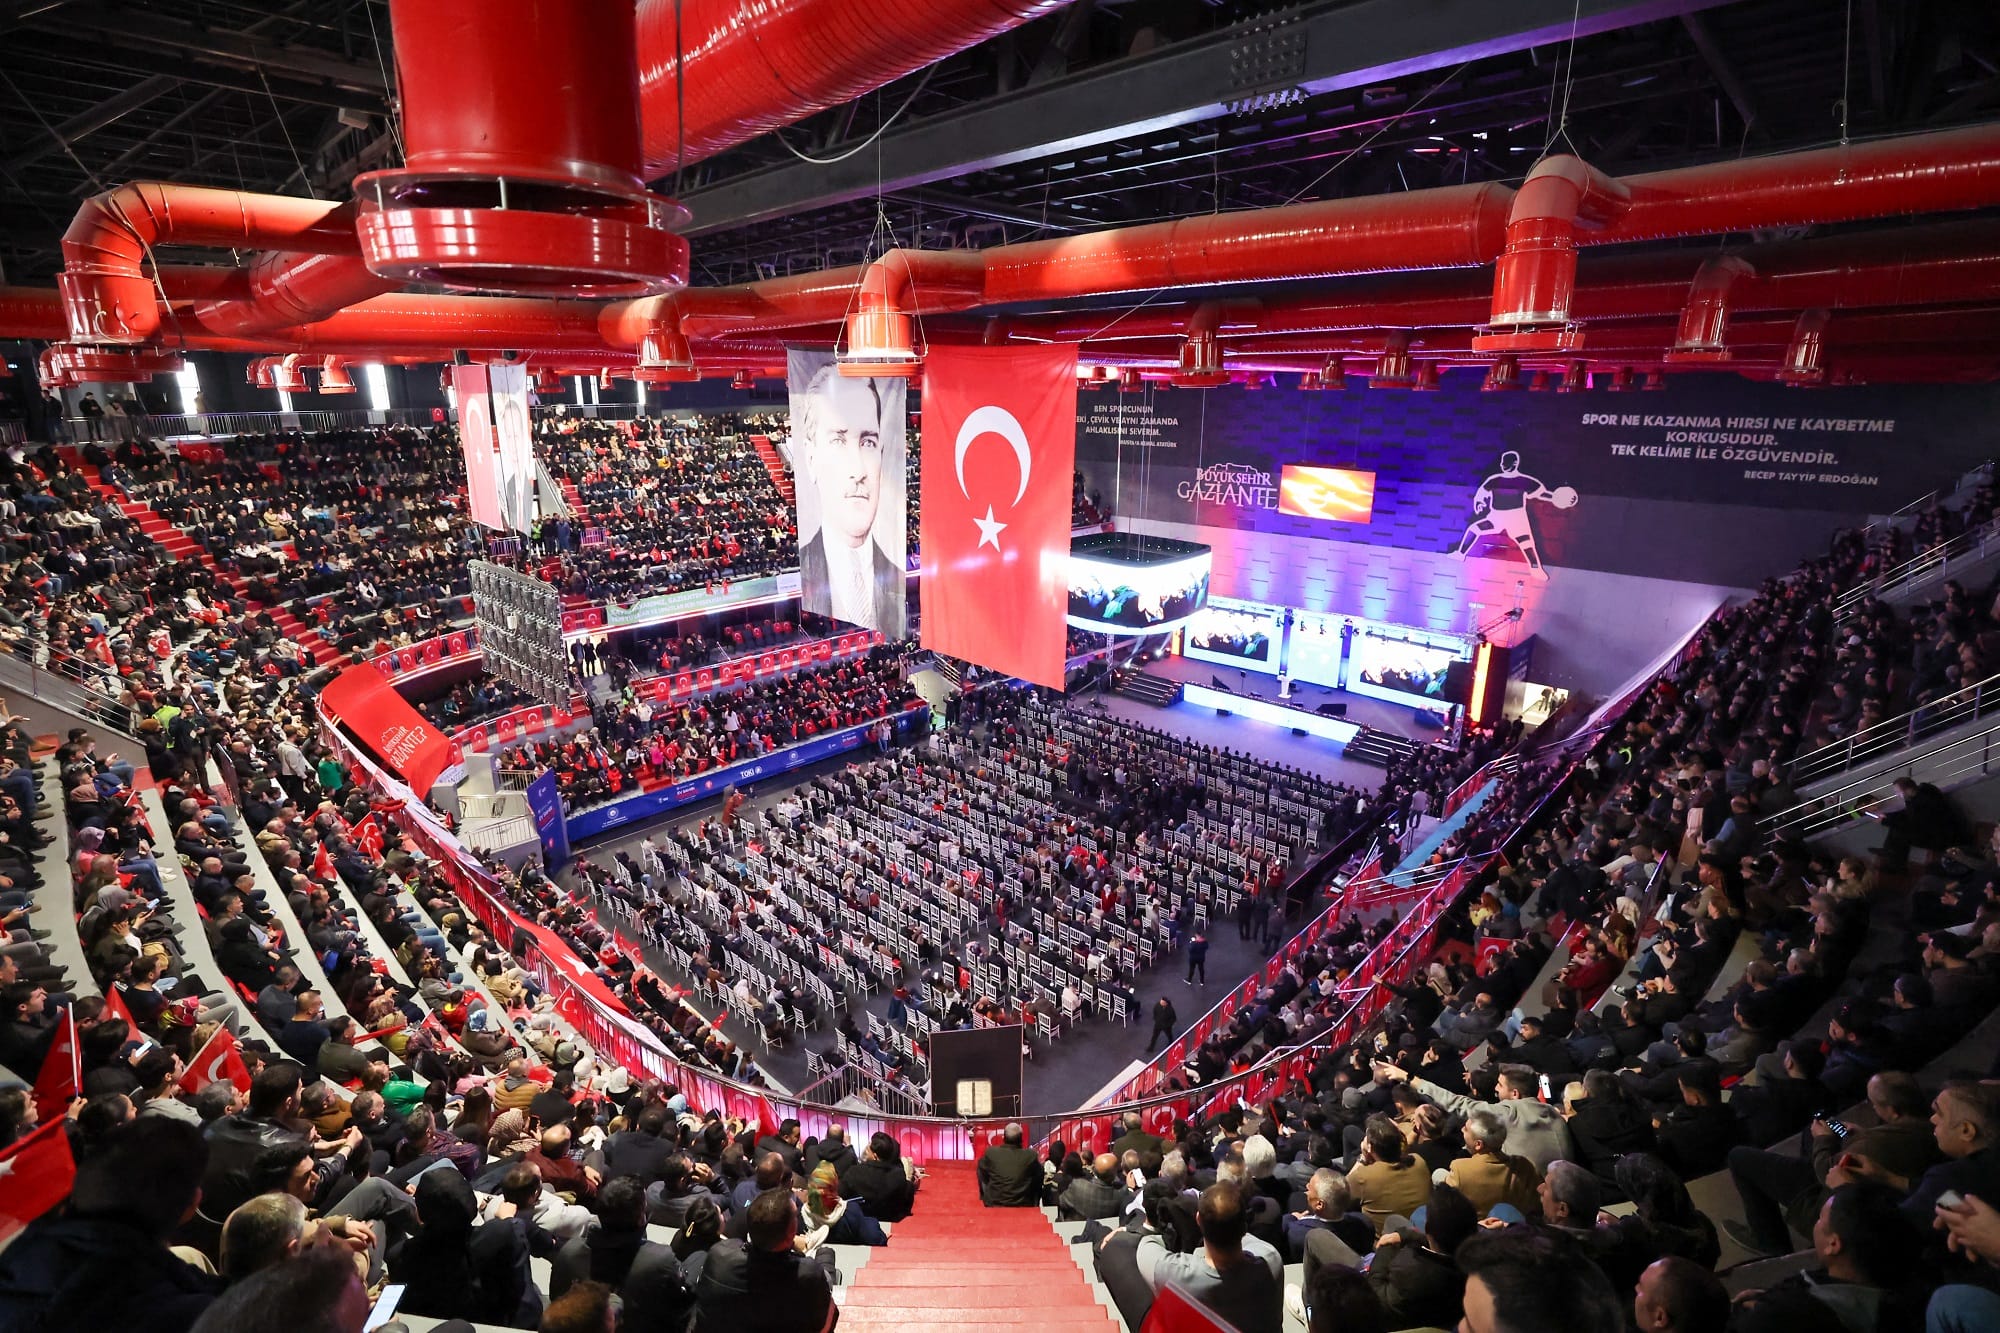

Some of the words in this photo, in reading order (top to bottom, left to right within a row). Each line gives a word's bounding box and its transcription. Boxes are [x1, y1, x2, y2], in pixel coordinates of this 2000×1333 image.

[1109, 405, 1153, 413] SPORCUNUN
[1090, 415, 1109, 425] ÇEVİK
[1140, 417, 1178, 425] ZAMANDA
[1582, 413, 1618, 425] SPOR
[1621, 415, 1640, 426] NE
[1643, 415, 1721, 428] KAZANMA
[1726, 417, 1769, 429] HIRSI
[1773, 418, 1796, 430] NE
[1801, 418, 1895, 432] KAYBETME
[1666, 431, 1778, 445] KORKUSUDUR.
[1611, 444, 1636, 455] TEK
[1639, 444, 1691, 458] KELİME
[1695, 445, 1717, 459] İLE
[1721, 445, 1838, 464] ÖZGÜVENDİR.
[1744, 470, 1775, 479] RECEP
[1778, 472, 1815, 482] TAYYİP
[1818, 473, 1878, 485] ERDOĞAN
[1177, 481, 1279, 510] GAZİANTE
